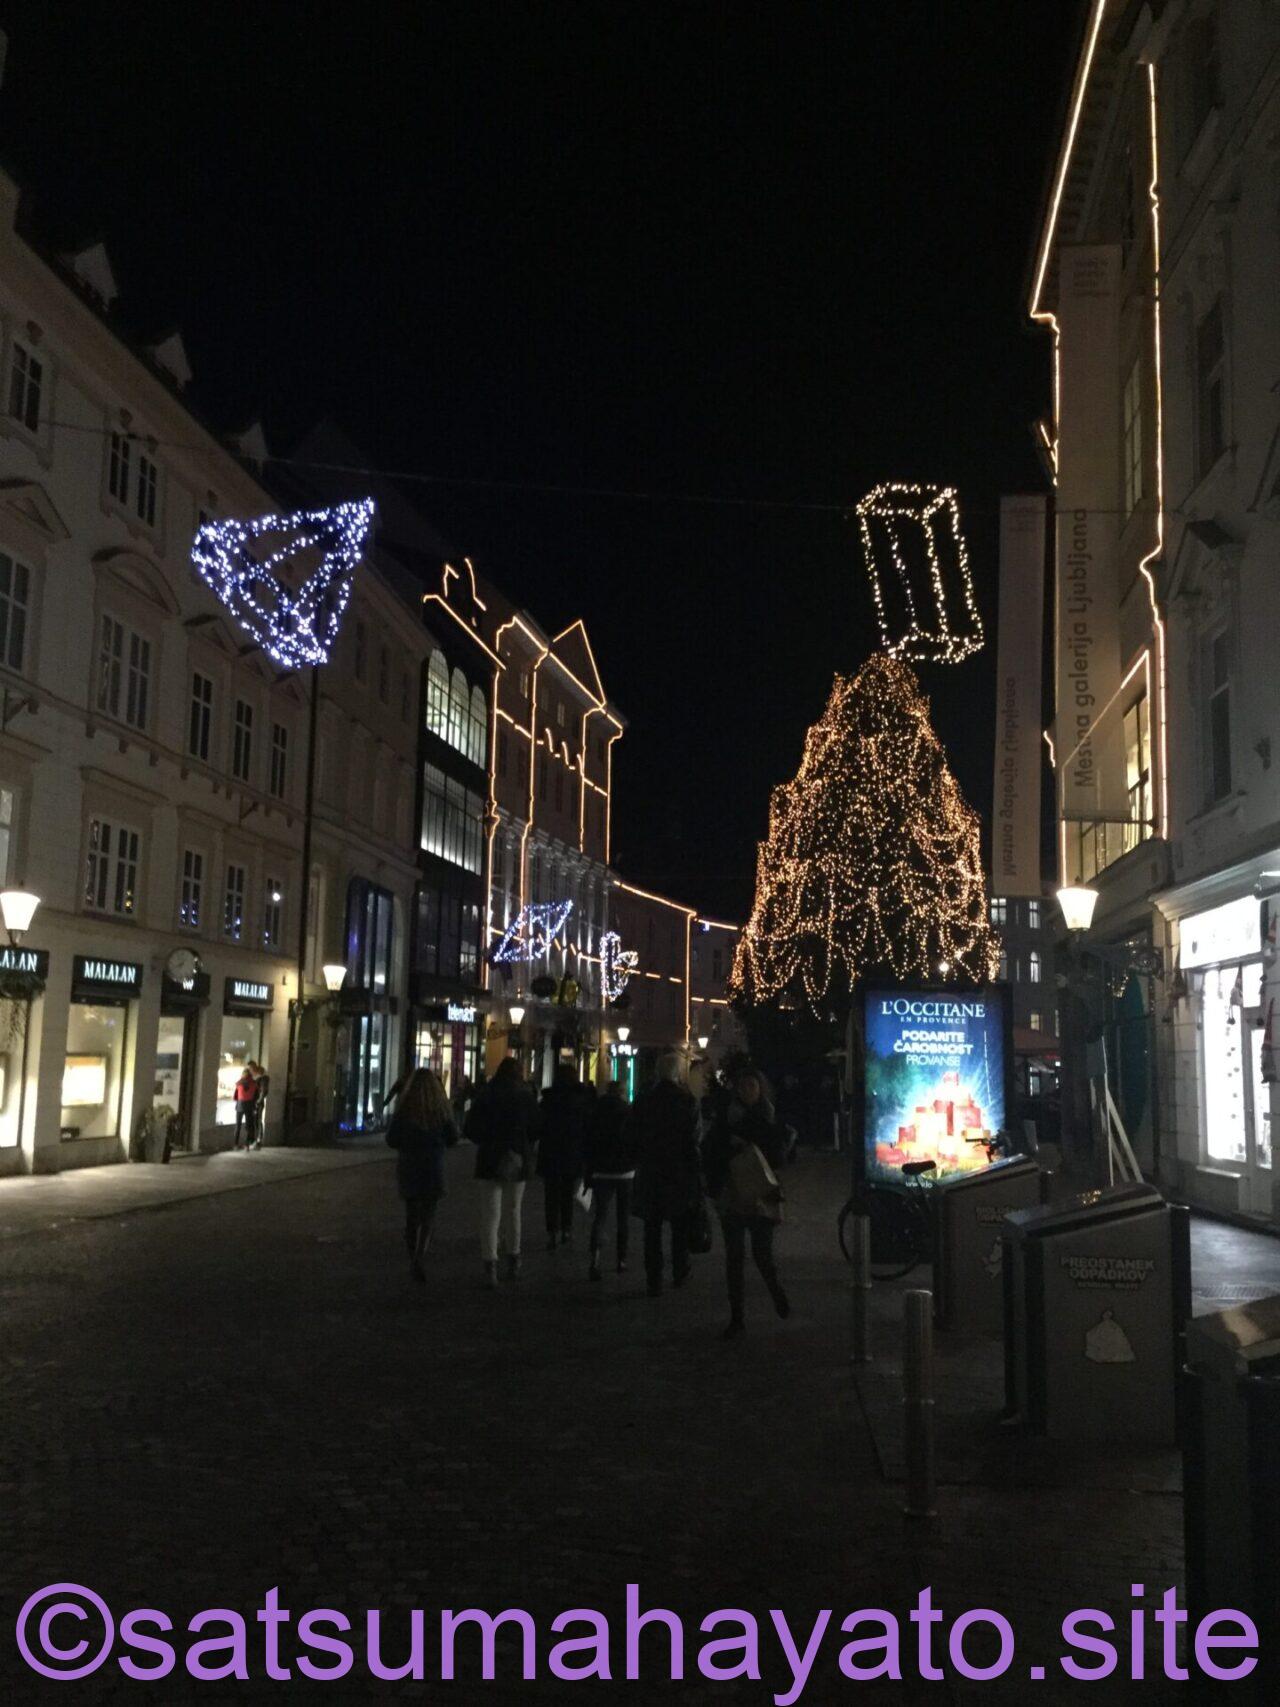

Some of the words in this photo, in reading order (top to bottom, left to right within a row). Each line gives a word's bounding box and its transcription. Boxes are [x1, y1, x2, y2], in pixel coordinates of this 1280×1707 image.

[1066, 508, 1093, 613] Ljubljana
[1067, 622, 1096, 707] galerija
[1073, 715, 1095, 787] Mestna
[0, 949, 38, 973] ALAN
[83, 960, 137, 984] MALALAN
[234, 981, 269, 1000] MALALAN
[881, 998, 986, 1018] L'OCCITANE
[917, 1017, 967, 1025] PROVENCE
[902, 1030, 965, 1043] PODARITE
[893, 1040, 974, 1055] ČAROBNOST
[906, 1054, 961, 1066] PROVANSE
[1061, 1256, 1154, 1270] PREOSTANEK
